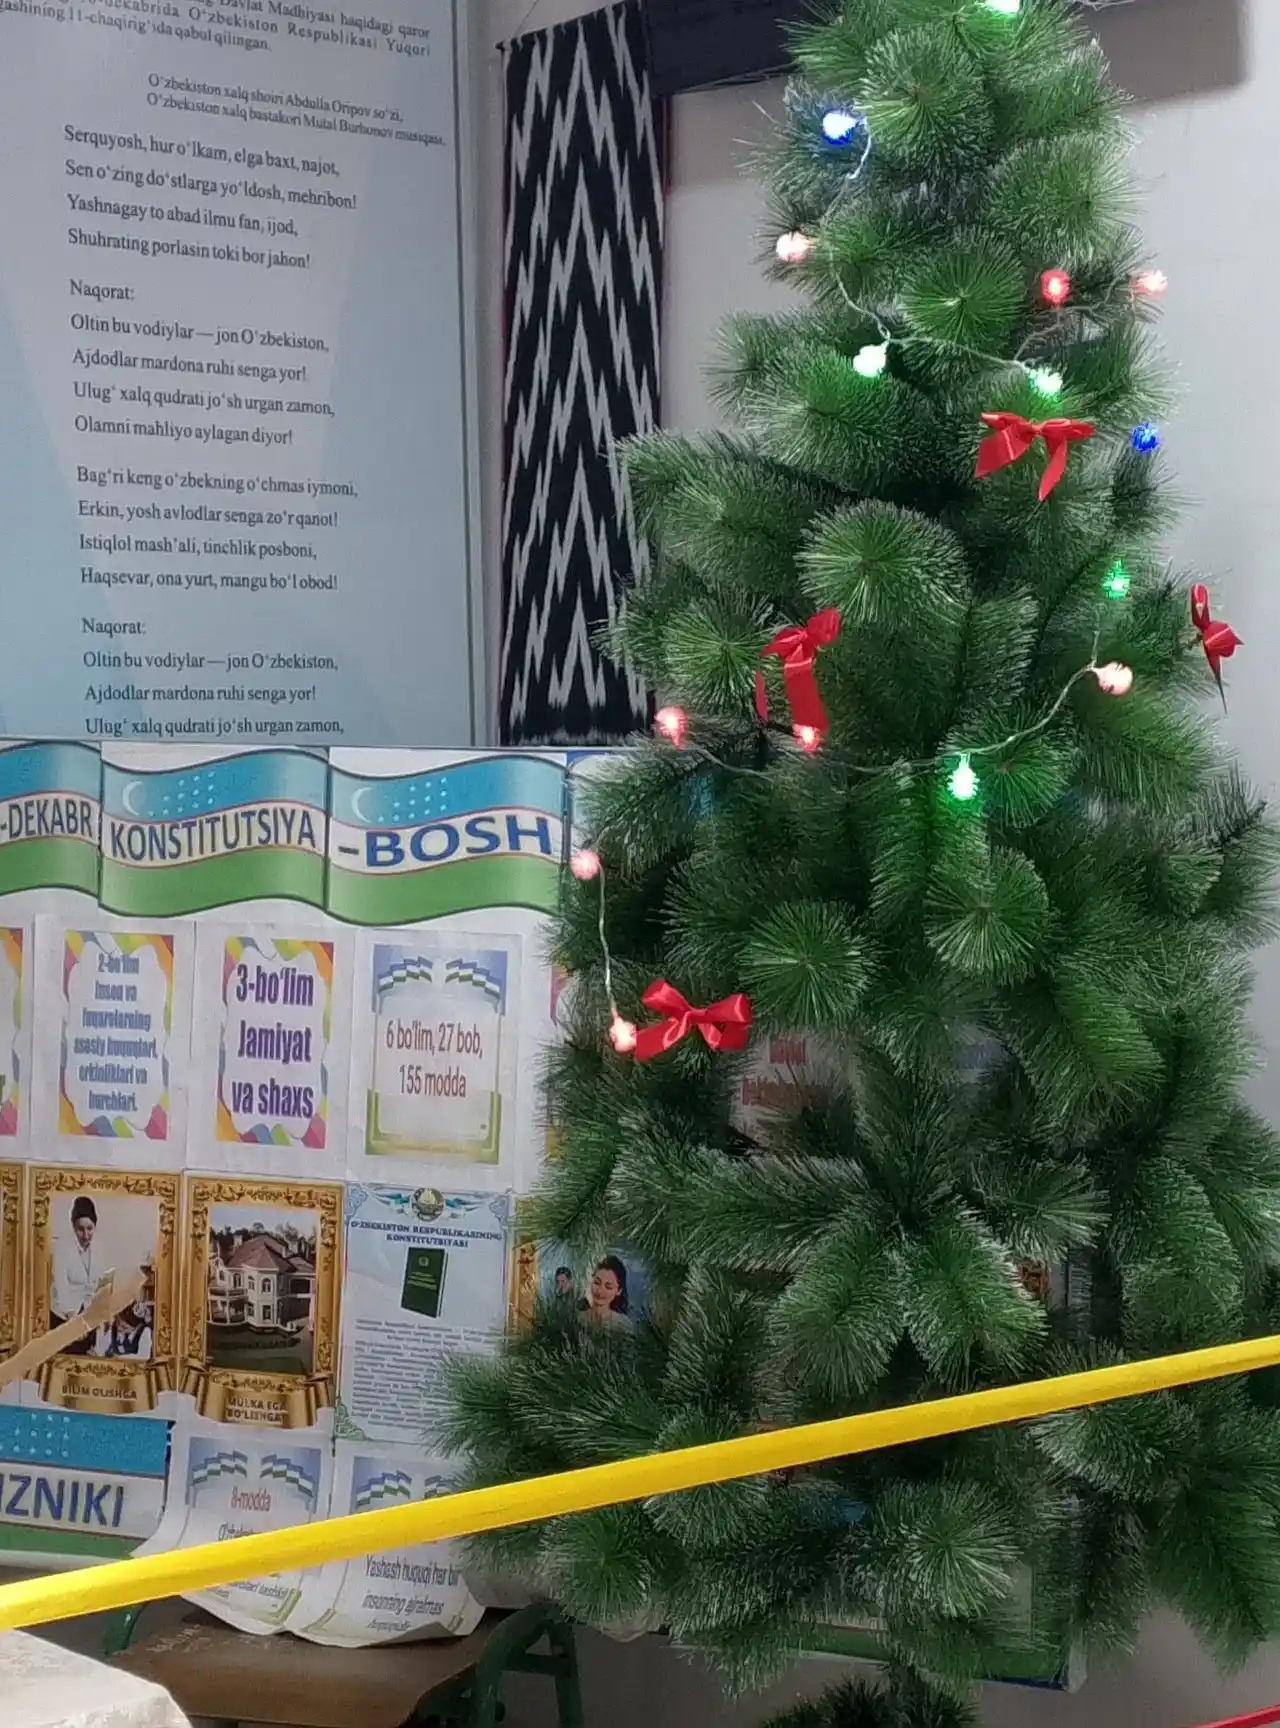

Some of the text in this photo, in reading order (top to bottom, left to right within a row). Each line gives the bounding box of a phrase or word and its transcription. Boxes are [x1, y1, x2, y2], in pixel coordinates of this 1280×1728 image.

[64, 124, 147, 152] Serquyosh,
[150, 135, 178, 154] hur
[234, 148, 264, 169] elga
[265, 151, 299, 172] baxt,
[301, 158, 340, 177] najot,
[69, 278, 135, 302] Naqorat:
[77, 466, 358, 498] Bag‘ri keng o‘zbekning o‘chmas iymoni,
[80, 533, 131, 555] Istiqlol
[203, 538, 256, 556] tinchlik
[259, 541, 317, 560] posboni,
[80, 567, 153, 588] Haqsevar,
[156, 574, 183, 586] ona
[185, 574, 217, 590] yurt,
[220, 576, 267, 592] mangu
[299, 574, 337, 590] obod!
[112, 809, 315, 860] KONSTITUTSIYA
[237, 1020, 312, 1064] Jamiyat
[386, 1021, 394, 1048] 6
[438, 1023, 454, 1052] 27
[457, 1024, 483, 1059] bob,
[231, 1078, 313, 1118] va shaxs
[399, 1065, 466, 1097] 155 modda
